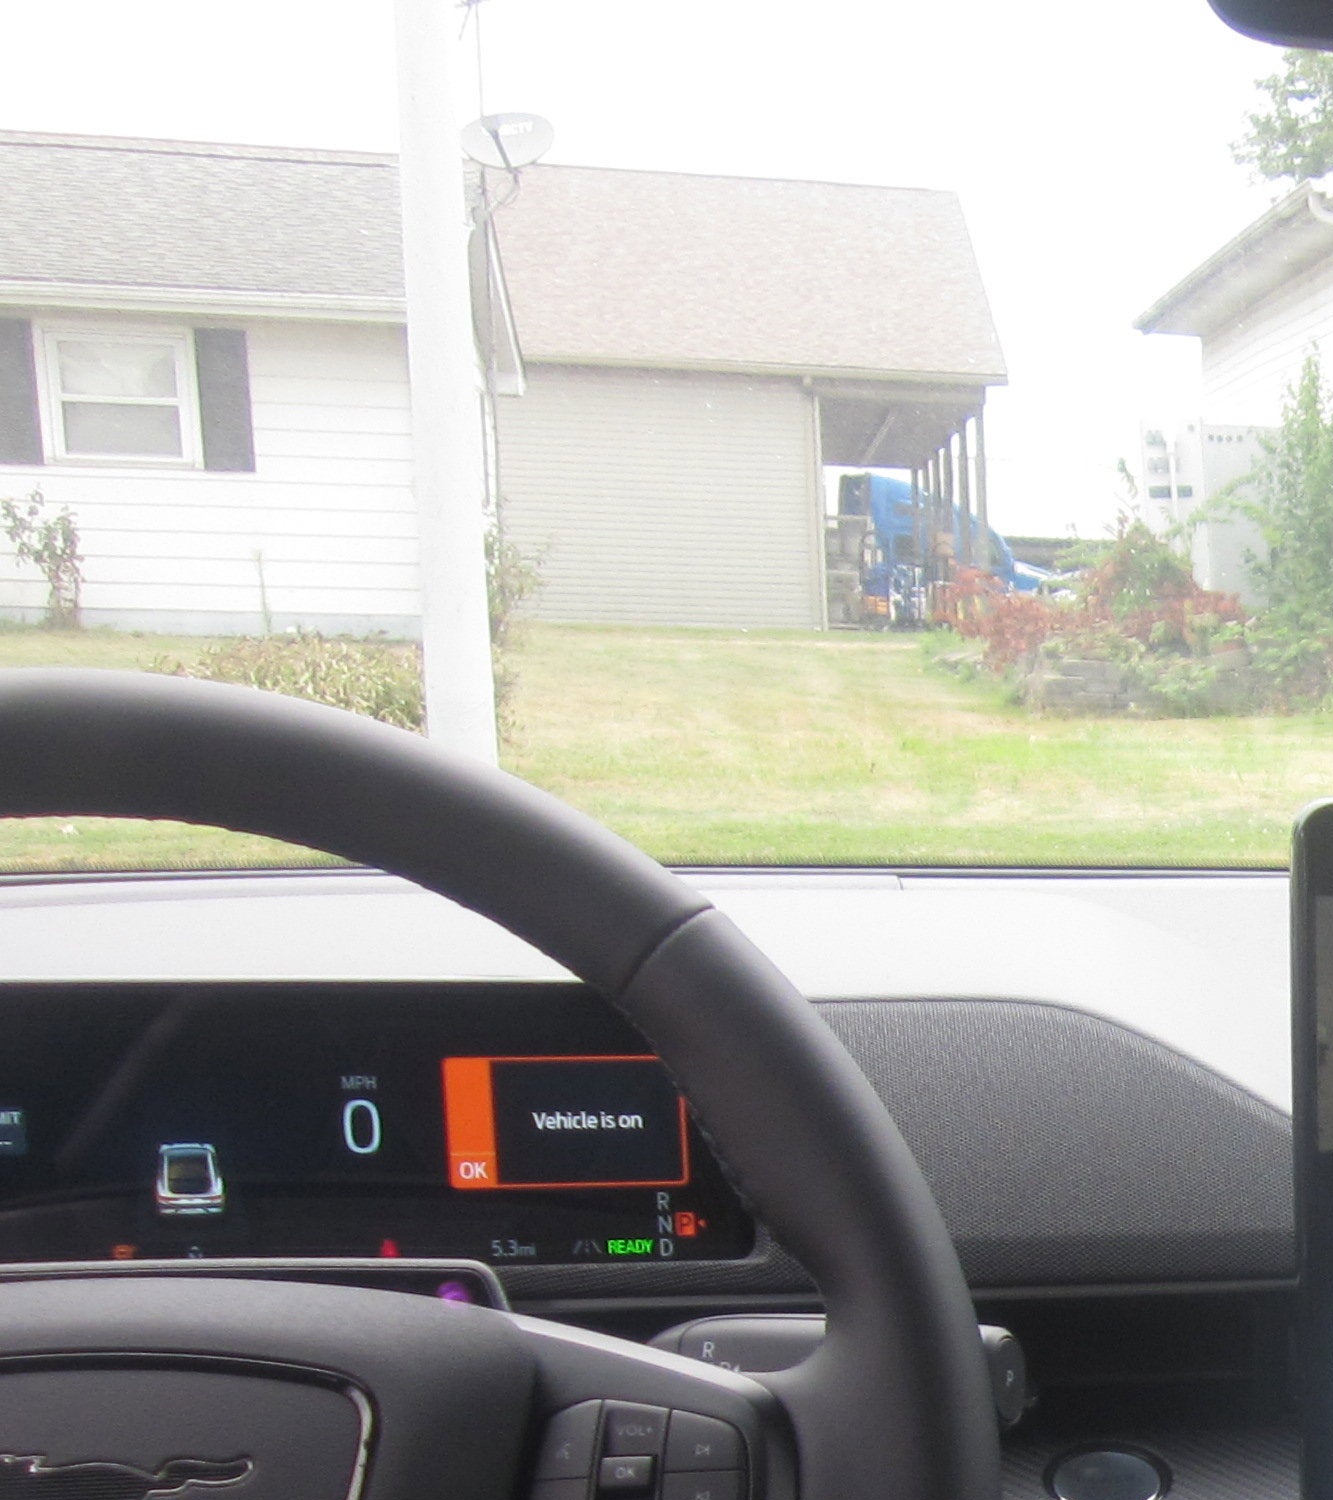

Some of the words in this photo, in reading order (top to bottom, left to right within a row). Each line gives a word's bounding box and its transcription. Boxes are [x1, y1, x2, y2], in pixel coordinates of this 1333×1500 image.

[341, 1076, 377, 1090] MPH
[343, 1099, 381, 1154] 0
[532, 1111, 598, 1130] Vehicle
[601, 1111, 615, 1129] is
[618, 1113, 643, 1129] on
[459, 1161, 488, 1179] OK
[657, 1191, 670, 1210] R
[657, 1215, 673, 1234] N
[607, 1239, 653, 1254] READY
[660, 1239, 673, 1257] D
